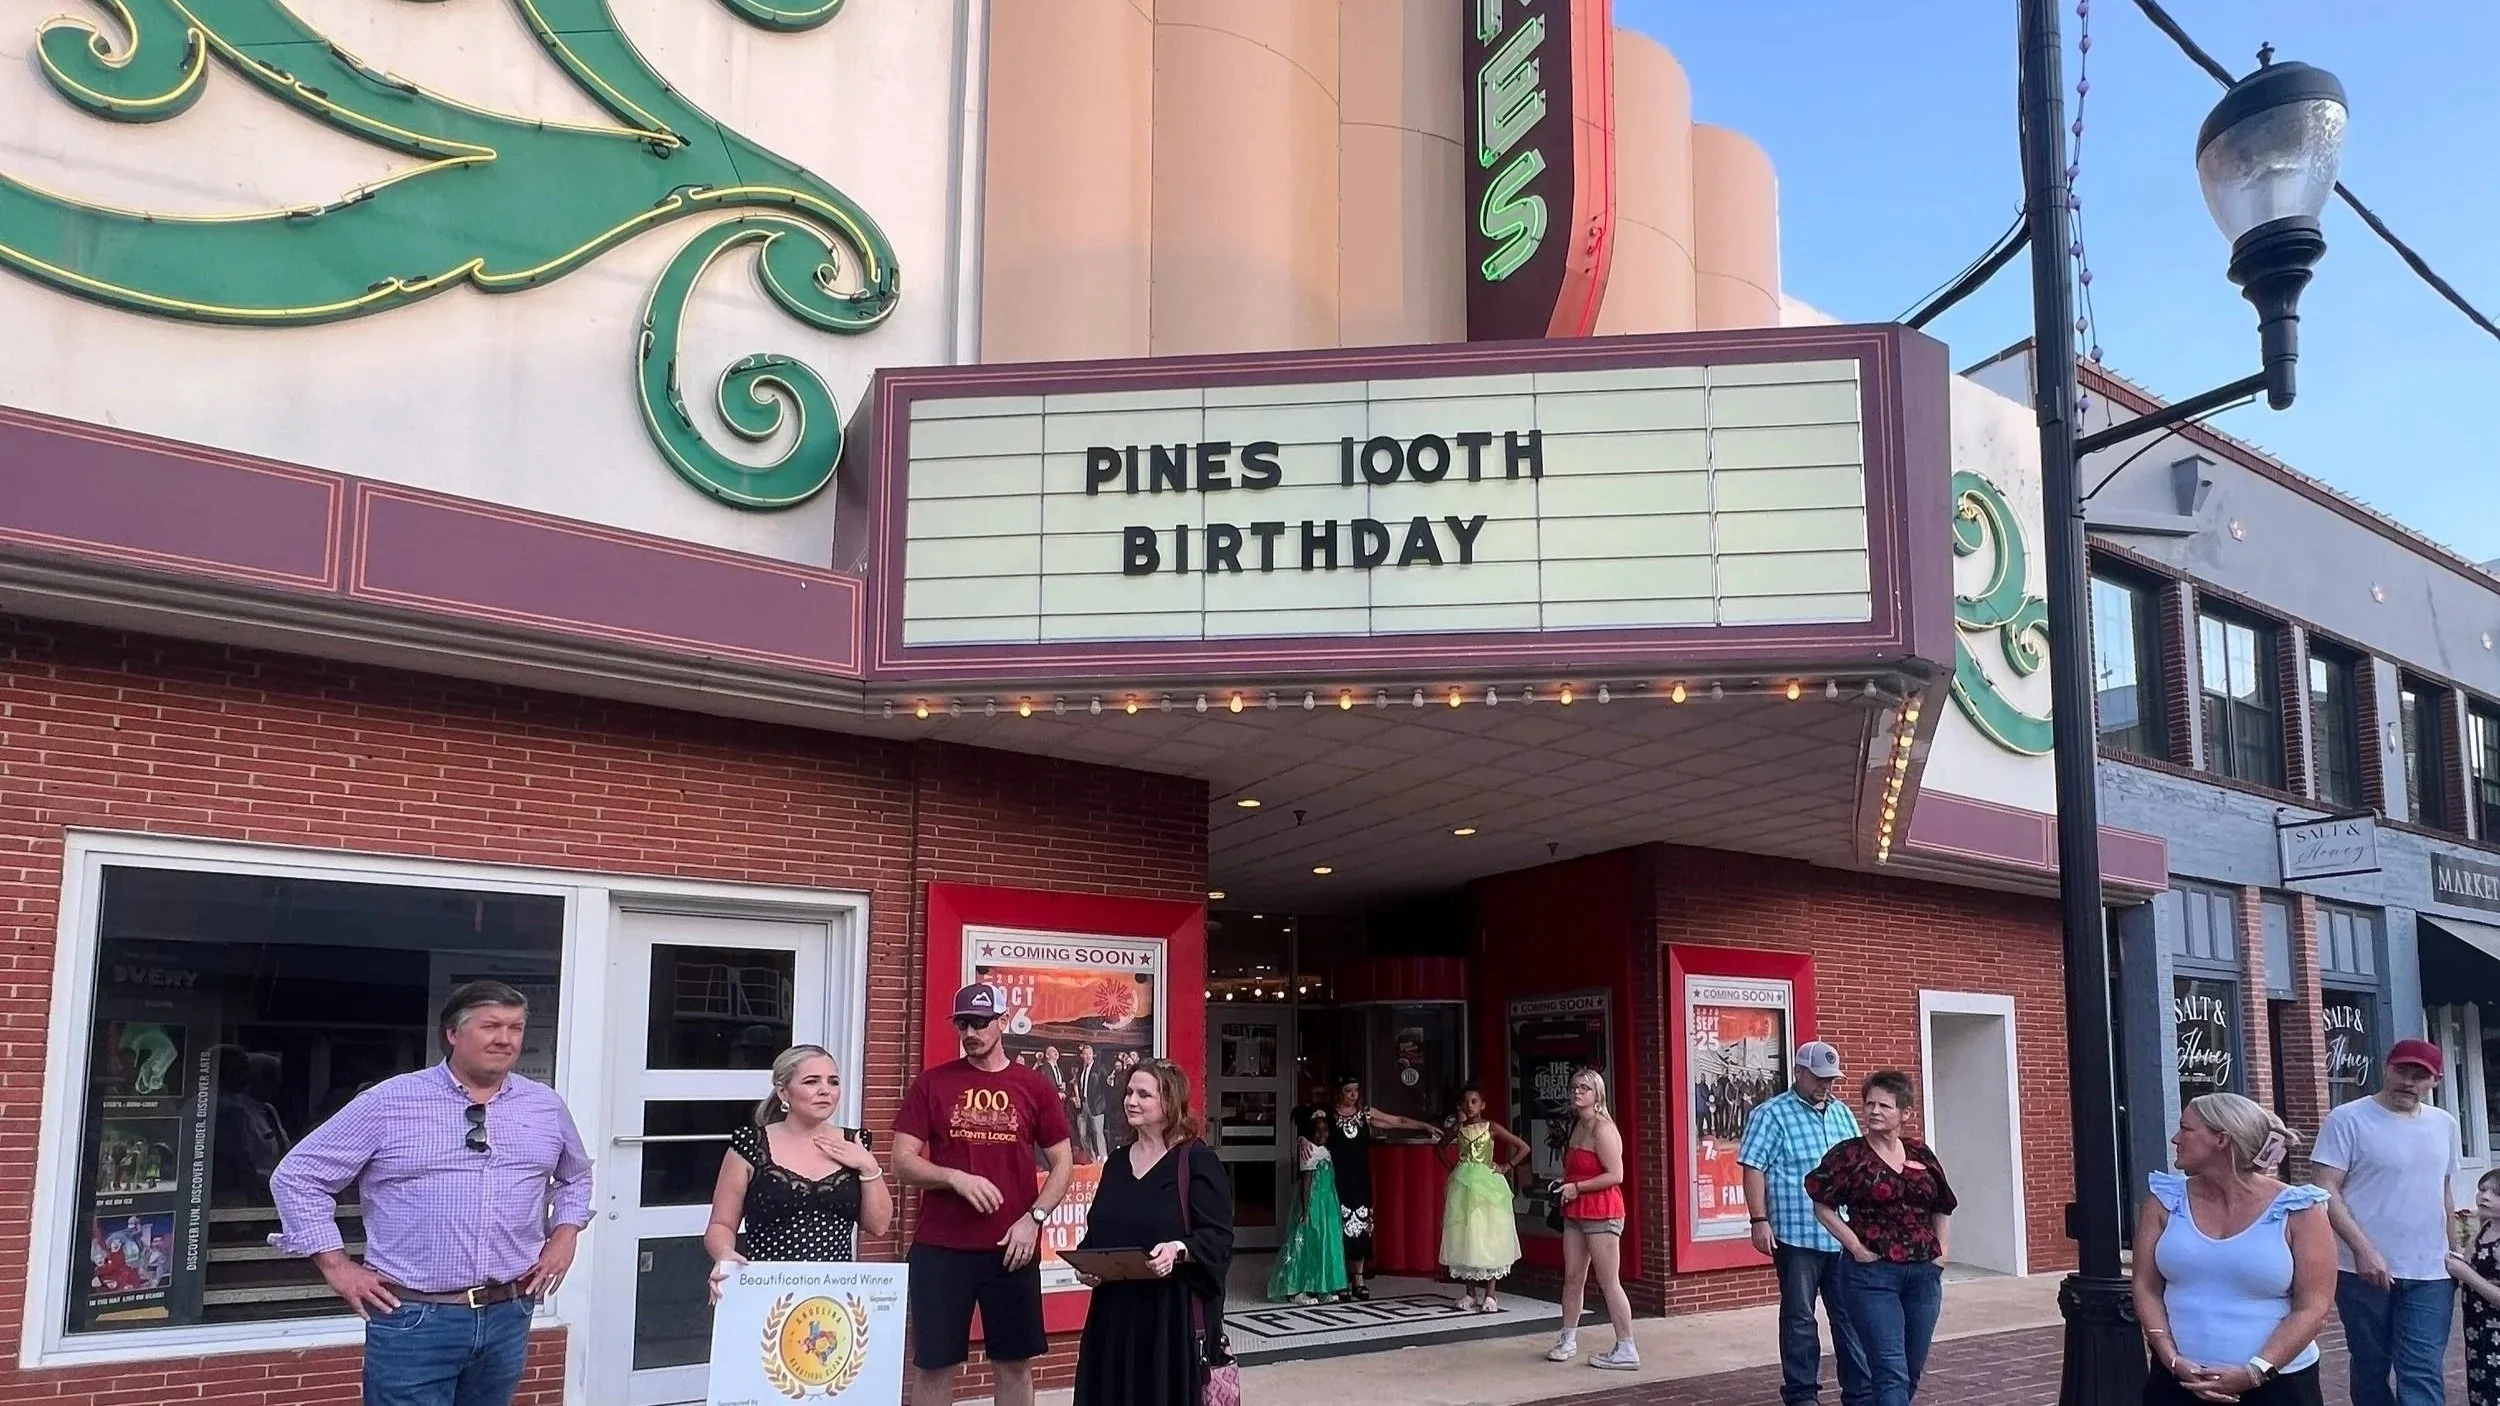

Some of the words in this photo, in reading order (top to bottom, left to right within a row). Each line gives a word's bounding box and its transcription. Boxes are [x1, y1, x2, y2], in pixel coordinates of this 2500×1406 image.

[1476, 0, 1548, 283] ES
[1086, 441, 1282, 495] PINES
[1341, 429, 1544, 487] 100TH
[1123, 515, 1487, 575] BIRTHDAY
[2296, 825, 2338, 844] SALT
[2346, 822, 2361, 836] &
[2438, 864, 2500, 901] MARKET
[1000, 945, 1070, 960] COMING
[1075, 949, 1135, 965] SOON
[1521, 1002, 1557, 1012] COMING
[1560, 998, 1594, 1010] SOON
[1703, 989, 1740, 1000] COMING
[1742, 990, 1774, 1002] SOON
[2174, 995, 2212, 1024] SALT
[2213, 1000, 2227, 1028] &
[2323, 1005, 2354, 1032] SALT
[2354, 1008, 2365, 1034] &
[1696, 1016, 1719, 1031] SEPT
[1696, 1031, 1720, 1051] 25
[1549, 1061, 1570, 1074] THE
[2178, 1027, 2233, 1087] Honey
[2326, 1034, 2371, 1087] Honey
[1535, 1074, 1569, 1088] GREAT
[196, 1075, 210, 1118] DISCOVER
[963, 1088, 1009, 1111] 100
[1540, 1087, 1569, 1100] ESCA
[988, 1131, 1017, 1142] LODGE
[190, 1160, 205, 1204] DISCOVER
[1046, 1226, 1067, 1249] TO
[185, 1227, 200, 1272] DISCOVER
[739, 1272, 820, 1286] Beautification
[823, 1274, 857, 1286] Award
[860, 1273, 893, 1285] Winner
[1245, 1299, 1469, 1331] PINES
